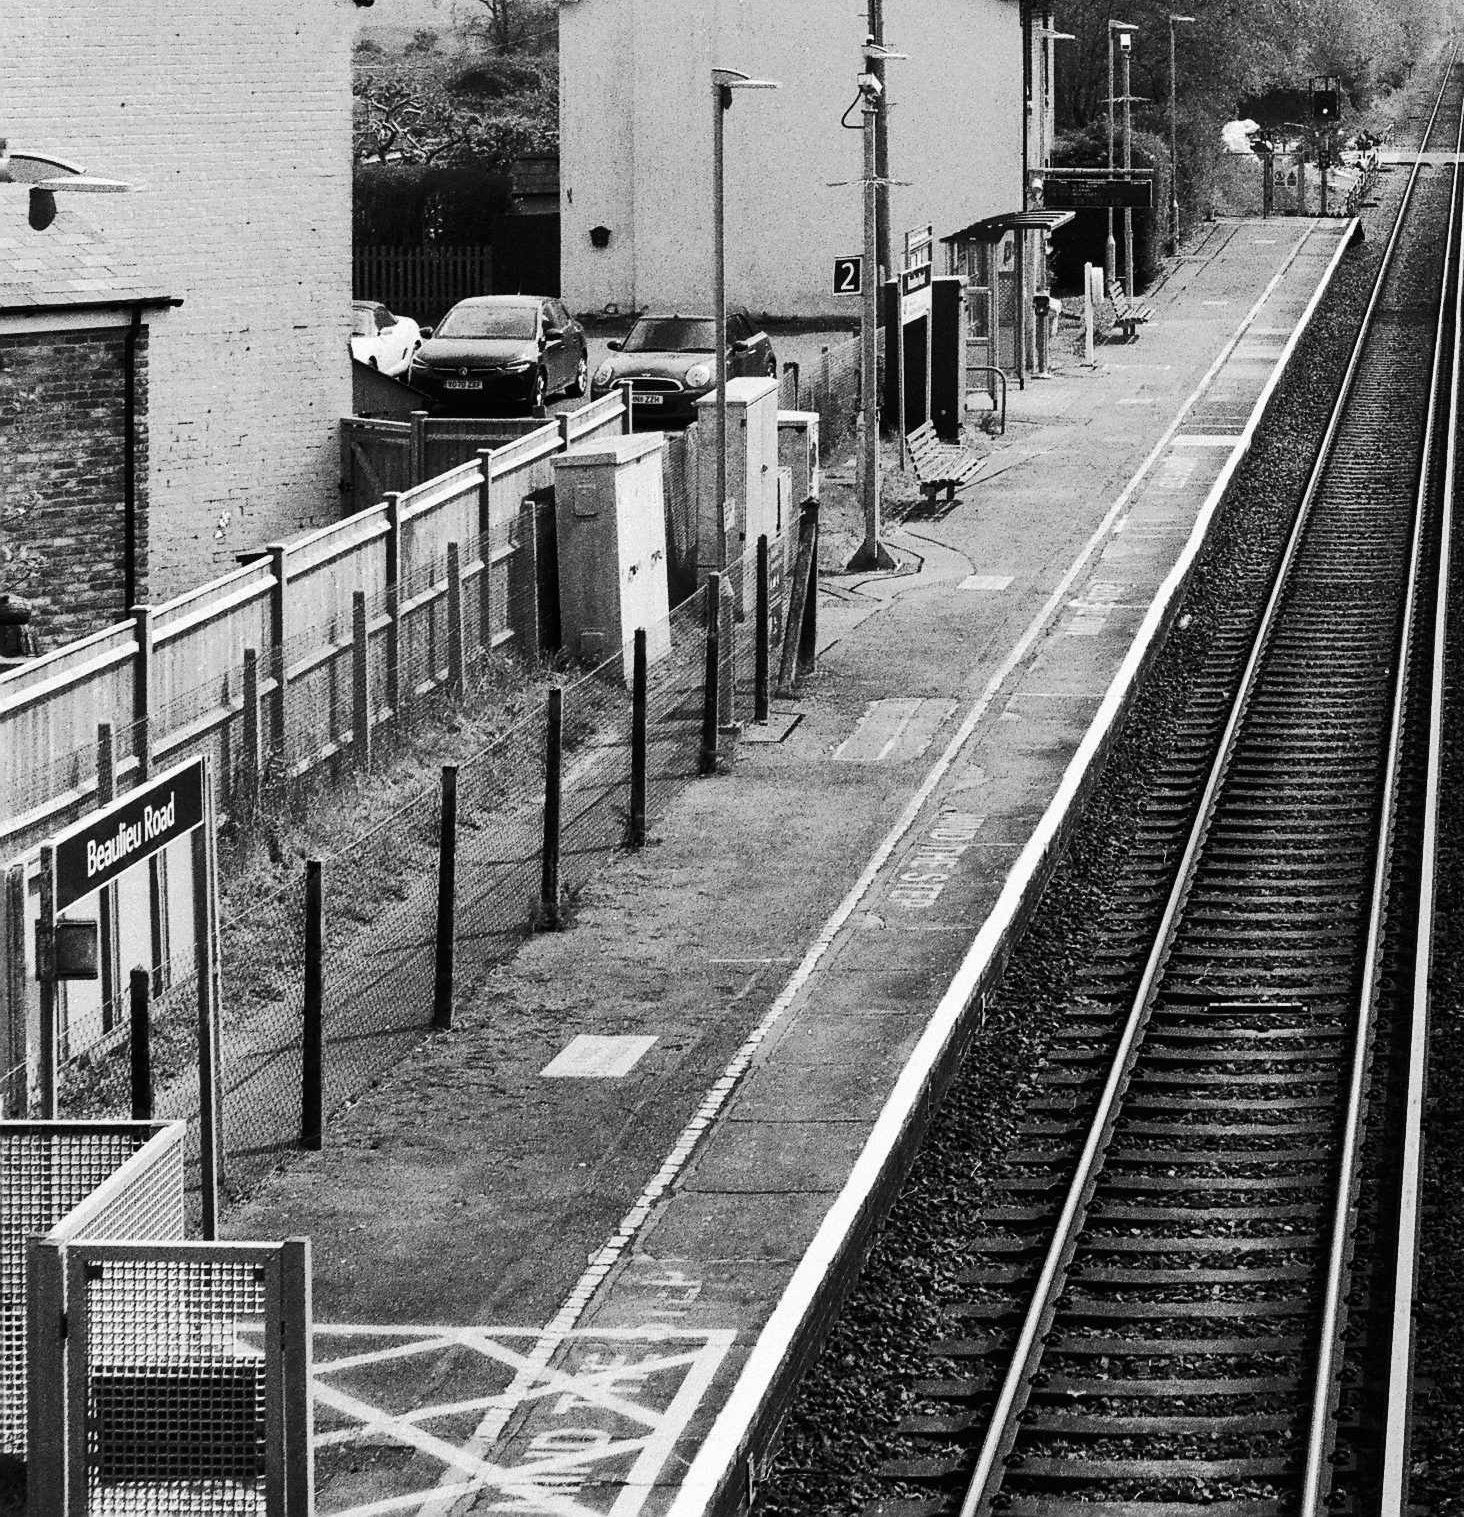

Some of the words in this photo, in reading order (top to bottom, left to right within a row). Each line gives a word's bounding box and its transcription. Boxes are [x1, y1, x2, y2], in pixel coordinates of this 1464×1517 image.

[841, 262, 855, 290] 2
[86, 821, 142, 878] Beaulieu
[144, 790, 175, 842] Road
[910, 844, 969, 868] THE
[888, 873, 950, 908] STEP
